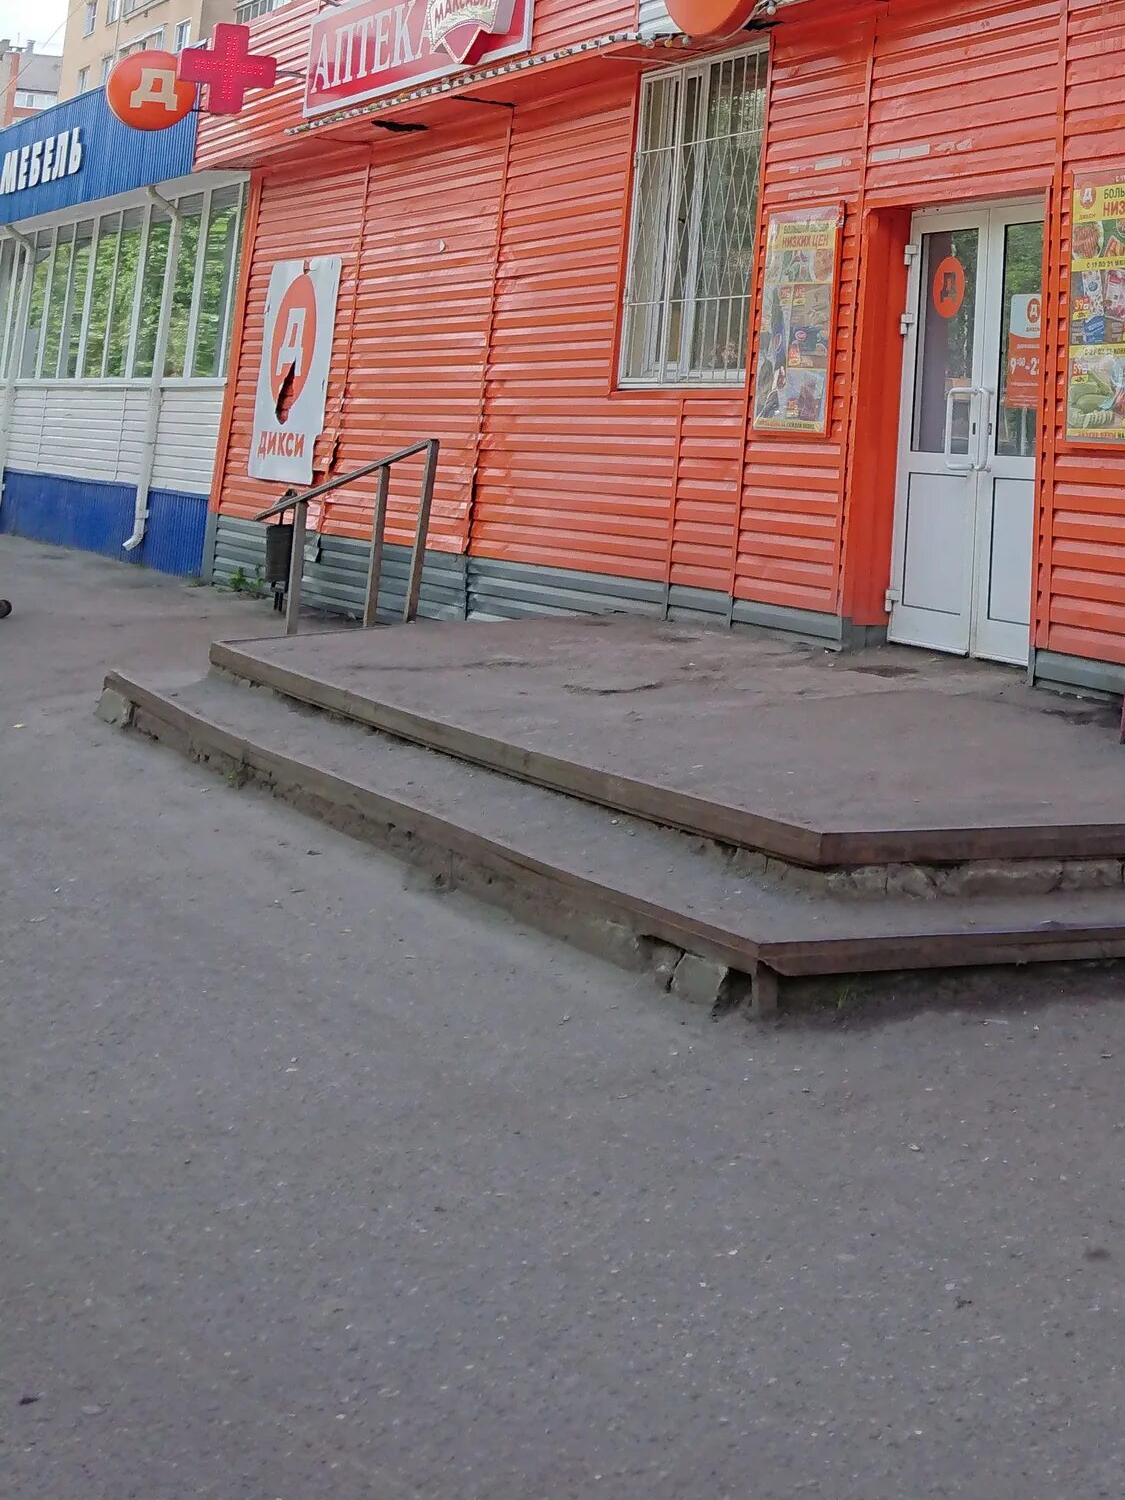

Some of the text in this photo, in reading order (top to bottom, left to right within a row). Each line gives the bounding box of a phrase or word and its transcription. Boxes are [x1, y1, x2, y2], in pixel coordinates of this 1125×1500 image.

[129, 67, 178, 112] Д
[0, 126, 83, 197] МЕБЕЛЬ
[940, 272, 957, 302] Д
[276, 307, 307, 377] Д
[257, 430, 306, 460] ДИКСИ
